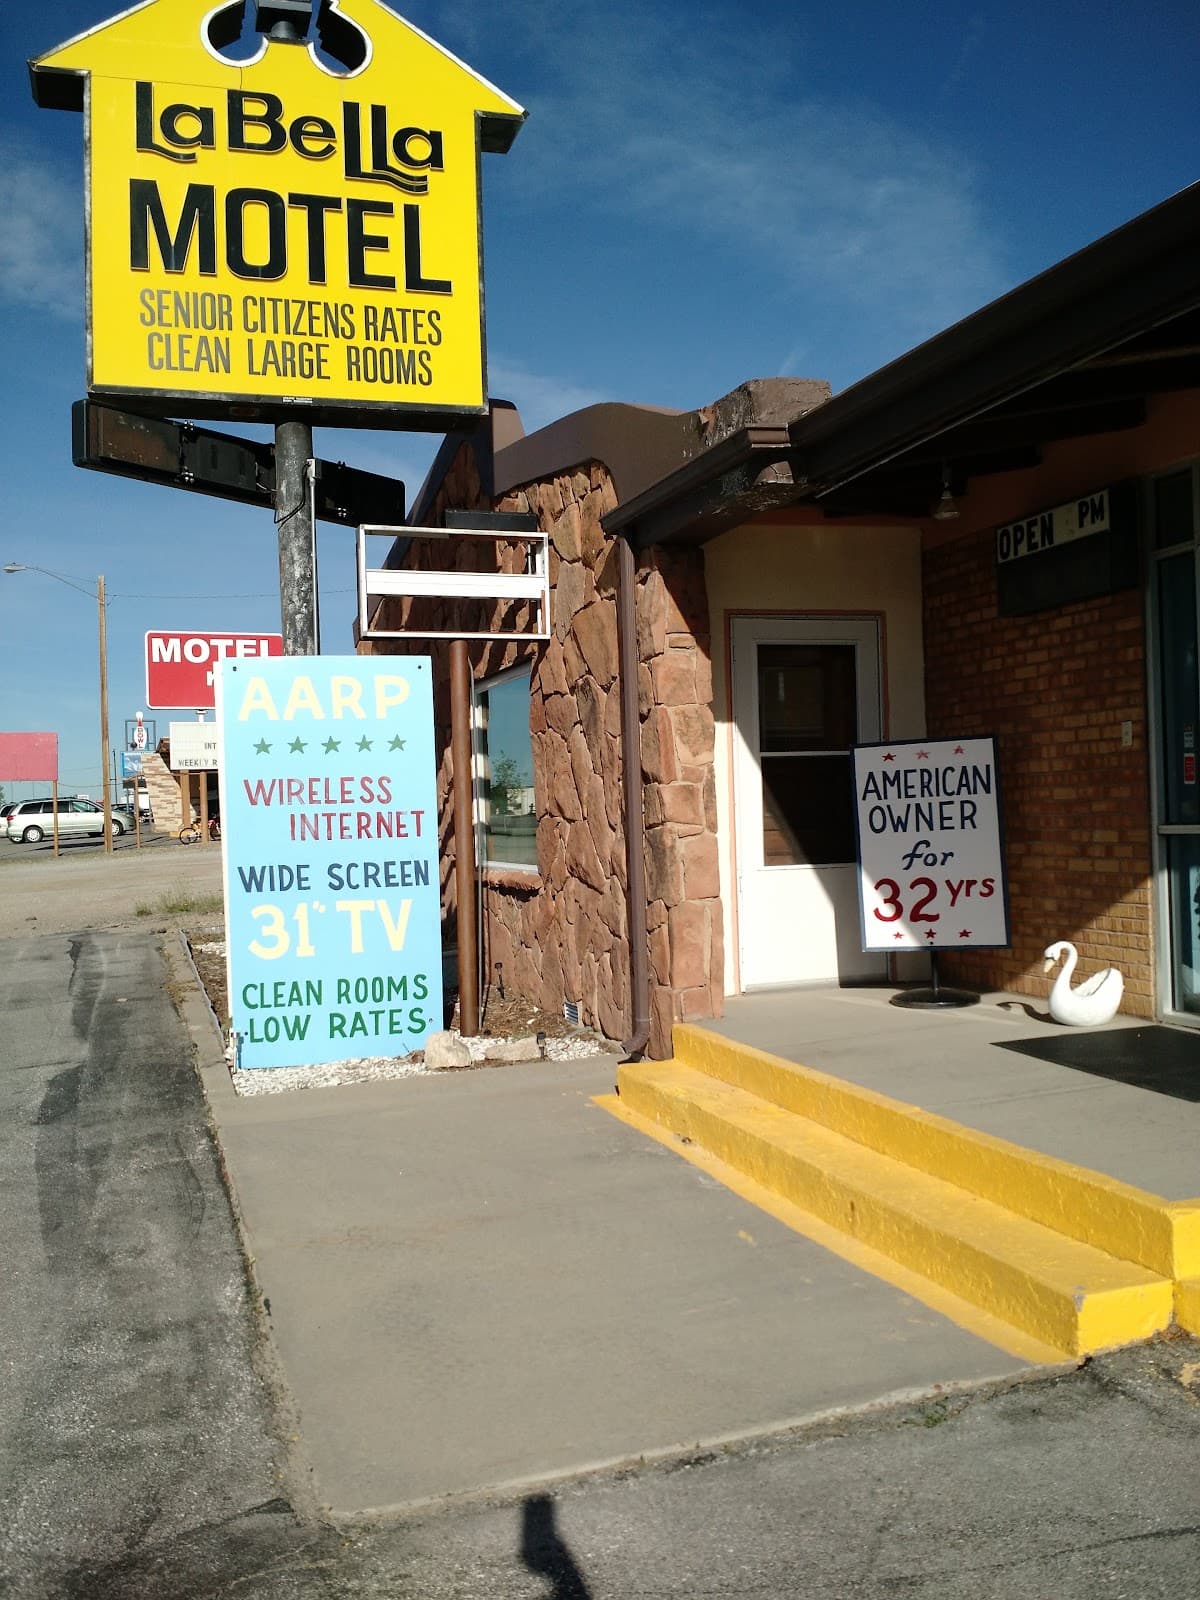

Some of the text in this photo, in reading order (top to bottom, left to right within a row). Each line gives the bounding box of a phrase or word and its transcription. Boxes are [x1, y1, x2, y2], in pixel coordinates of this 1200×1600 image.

[129, 178, 453, 295] MOTEL
[139, 288, 442, 346] SENIOR CITIZENS RATES
[148, 332, 433, 386] CLEAN LARGE ROOMS
[999, 492, 1105, 560] OPEN PM
[238, 675, 410, 721] AARP
[243, 775, 392, 807] WIRELESS
[862, 764, 991, 801] AMERICAN
[290, 810, 425, 841] INTERNET
[868, 800, 977, 834] OWNER
[902, 839, 954, 870] for
[238, 860, 430, 893] WIDE SCREEN
[873, 877, 996, 922] 32 yrs
[336, 899, 413, 954] TV
[242, 974, 428, 1009] CLEAN ROOMS
[249, 1007, 427, 1043] LOW RATES
